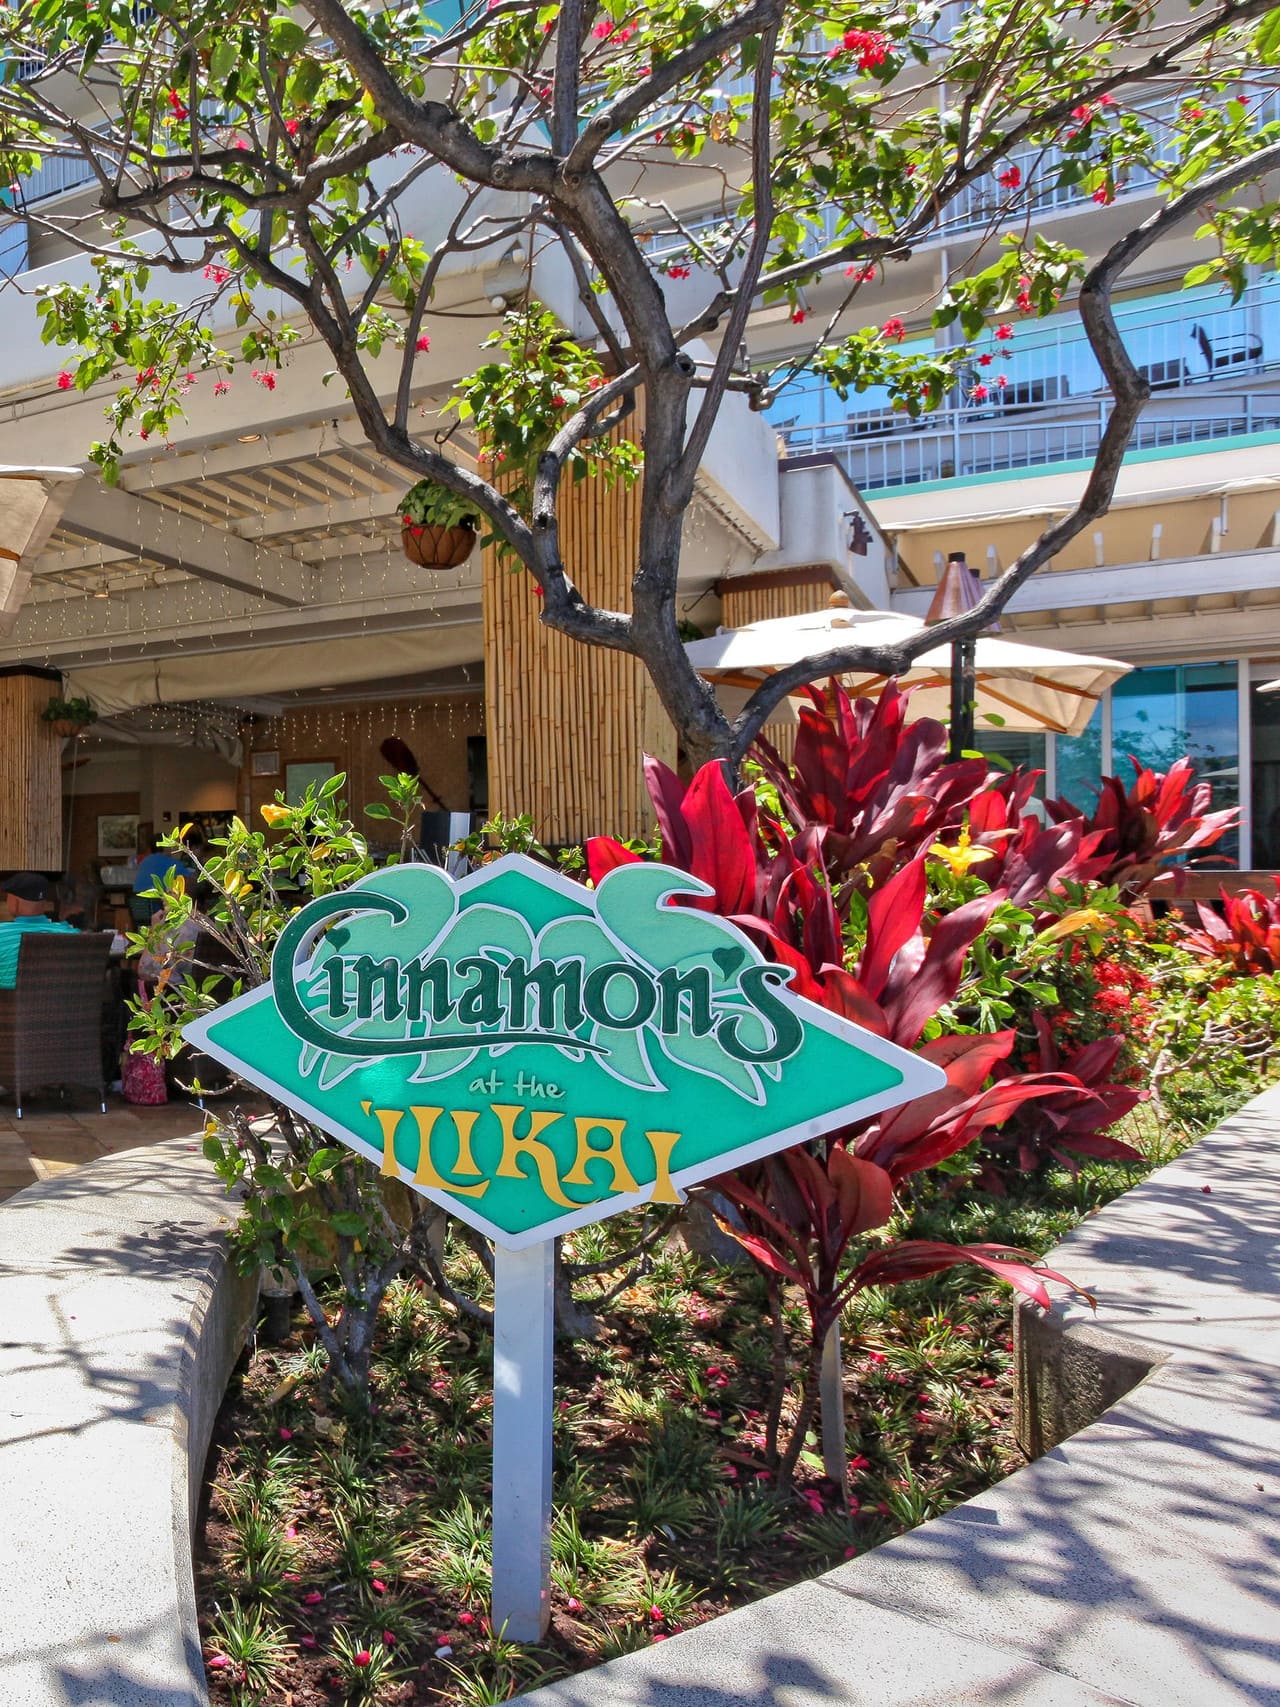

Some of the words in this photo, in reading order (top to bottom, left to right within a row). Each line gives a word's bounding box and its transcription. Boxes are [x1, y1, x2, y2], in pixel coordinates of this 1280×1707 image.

[272, 890, 804, 1064] Cinnamon's
[469, 1069, 503, 1095] at
[513, 1071, 566, 1098] the
